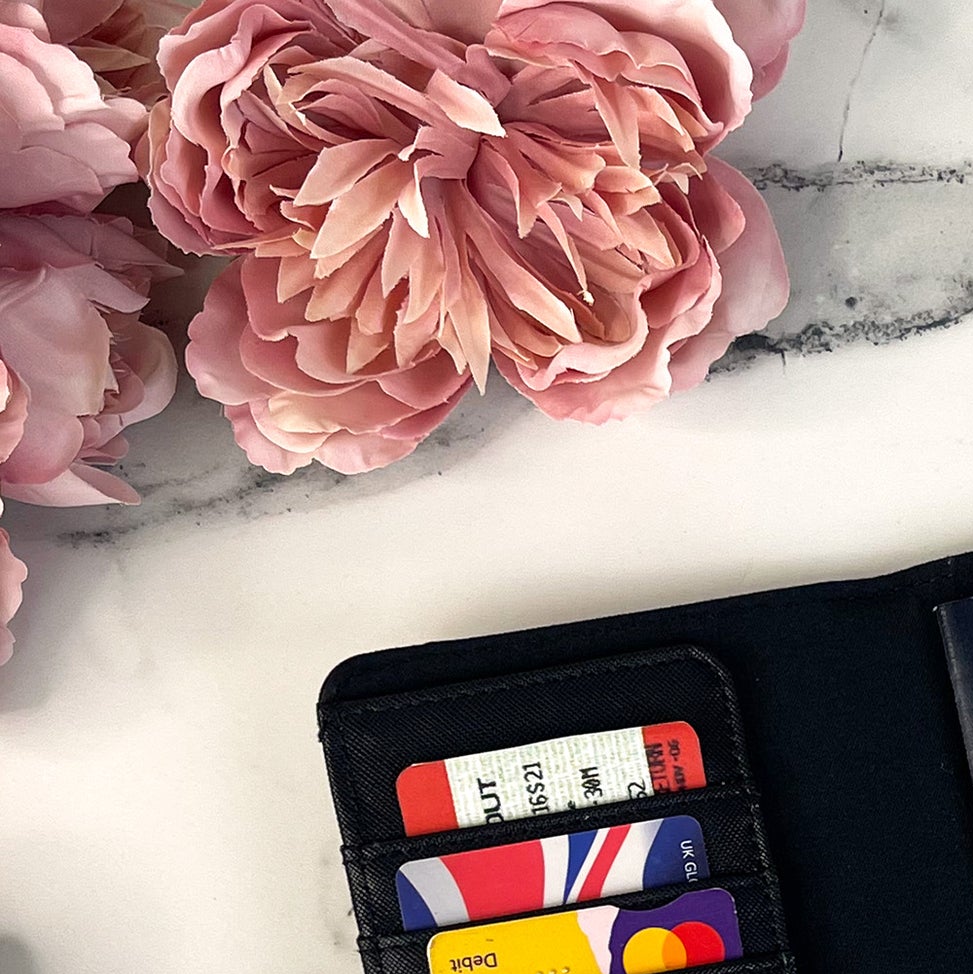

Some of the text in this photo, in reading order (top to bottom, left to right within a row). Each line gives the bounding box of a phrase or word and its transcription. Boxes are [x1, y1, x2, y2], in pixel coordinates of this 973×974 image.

[680, 840, 698, 882] UK GL
[449, 952, 498, 973] Debit
